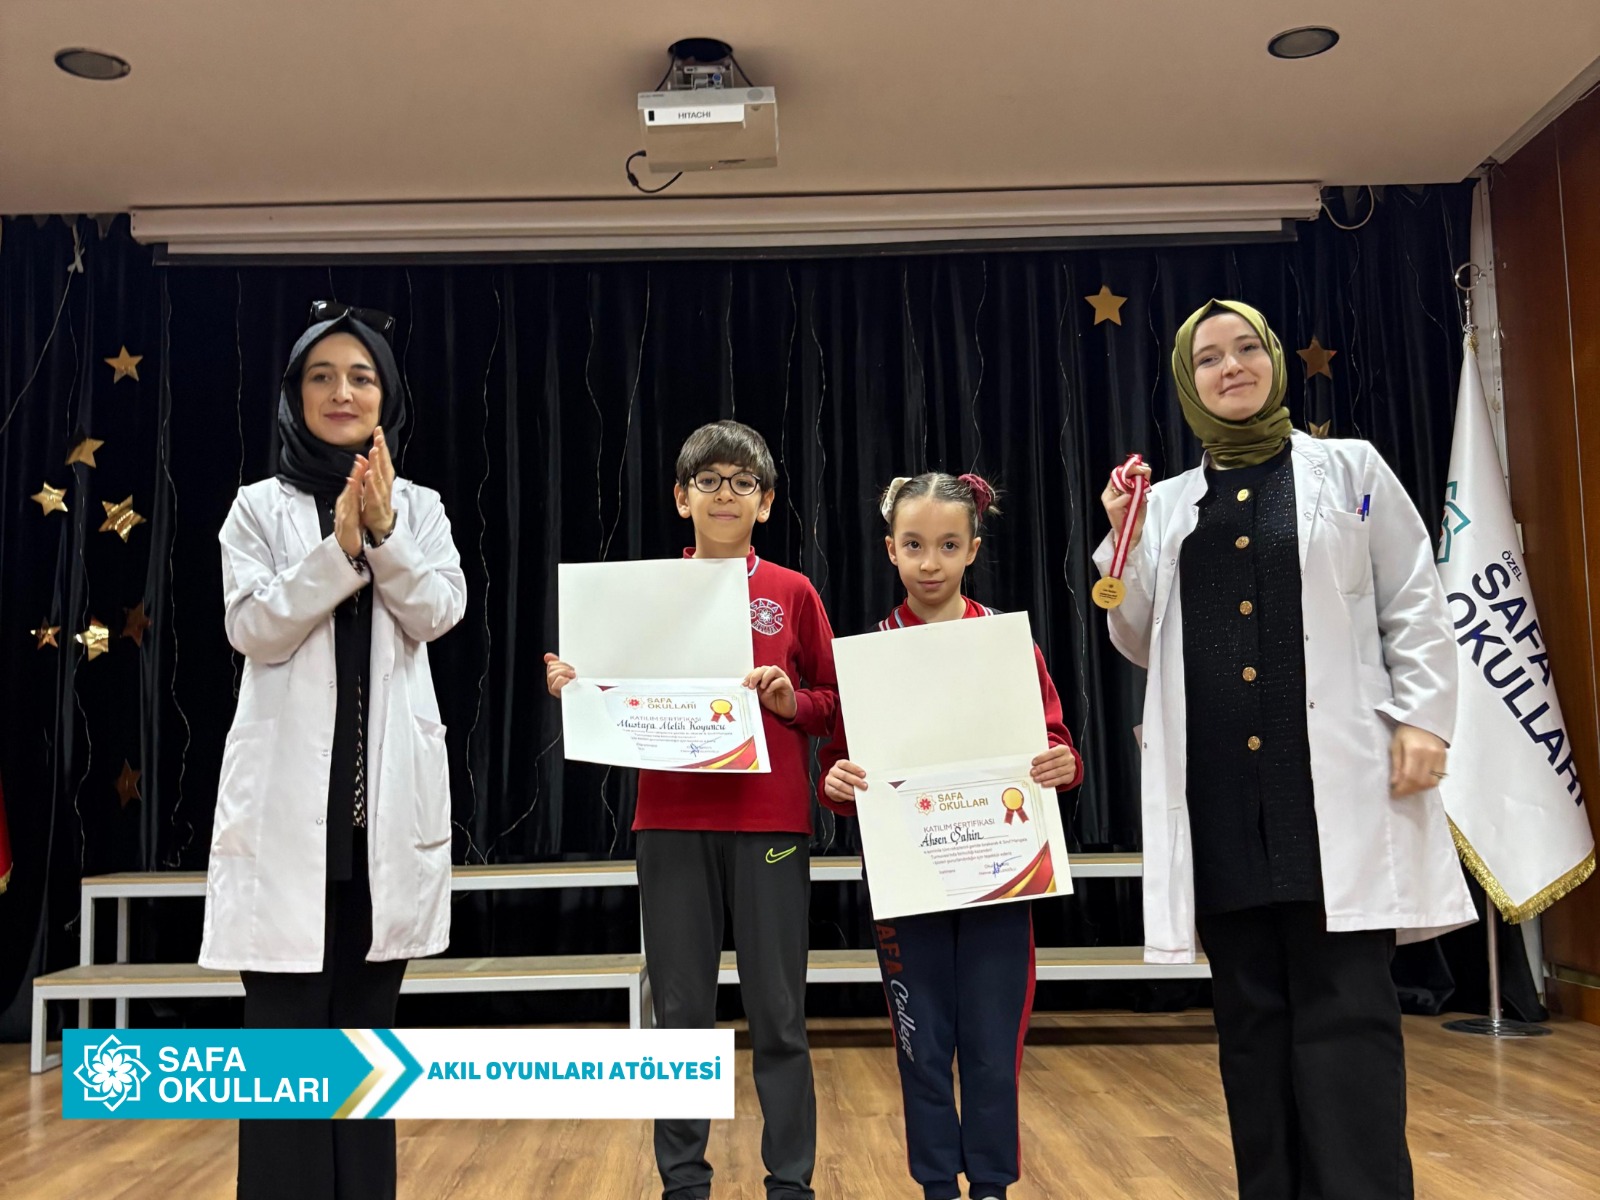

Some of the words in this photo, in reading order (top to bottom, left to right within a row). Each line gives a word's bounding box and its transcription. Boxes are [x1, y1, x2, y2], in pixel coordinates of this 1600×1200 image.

[678, 111, 711, 119] HITACHI
[1502, 550, 1523, 582] ÖZEL
[1471, 562, 1551, 686] SAFA
[617, 720, 656, 732] Mustafa
[659, 721, 686, 730] Melih
[937, 792, 964, 802] SAFA
[939, 797, 989, 811] OKULLARI
[923, 824, 953, 833] KATILIM
[920, 832, 948, 848] Ahsen
[890, 979, 915, 1063] College
